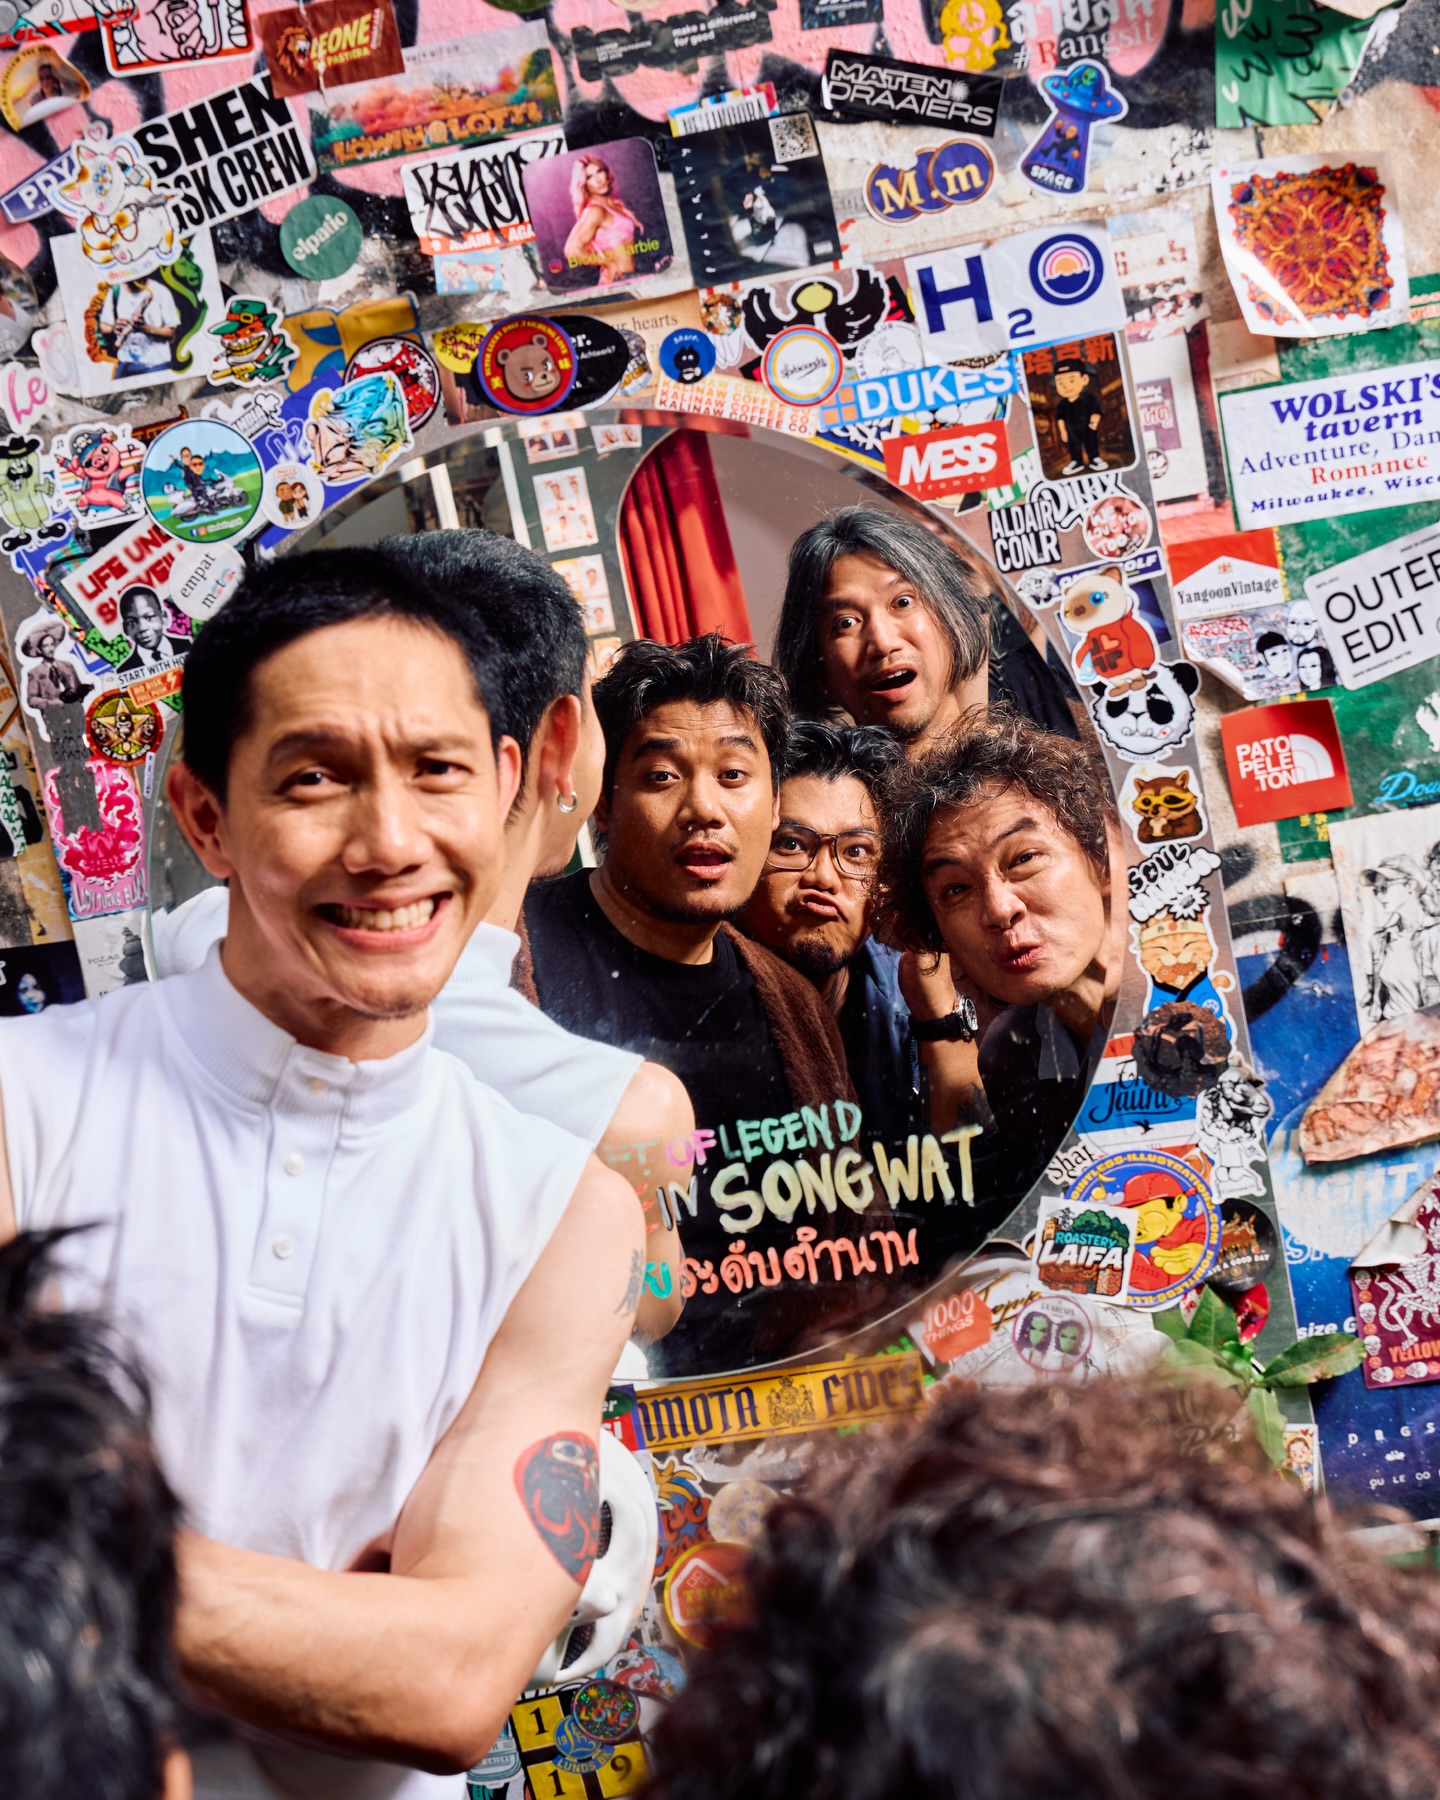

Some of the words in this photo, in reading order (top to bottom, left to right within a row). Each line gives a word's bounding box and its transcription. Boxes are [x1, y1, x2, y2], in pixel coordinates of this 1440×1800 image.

[310, 13, 372, 60] LEONE
[672, 24, 697, 38] make
[700, 22, 706, 31] a
[708, 11, 757, 29] difference
[674, 36, 692, 47] for
[695, 30, 715, 45] good
[829, 59, 953, 102] MATEN
[828, 79, 994, 127] DRAAIERS
[133, 74, 293, 178] SHEN
[217, 127, 312, 210] CREW
[1030, 164, 1074, 190] SPACE
[292, 209, 348, 262] elpatio
[632, 313, 678, 331] hearts
[661, 389, 725, 408] KALINAW
[731, 402, 785, 421] COFFEE
[856, 361, 1014, 419] DUKES
[659, 399, 723, 418] KALINAW
[729, 411, 784, 430] COFFEE
[788, 423, 812, 436] CO.
[1304, 408, 1423, 442] tavern
[898, 432, 999, 487] MESS
[1239, 440, 1379, 476] Adventure,
[1310, 454, 1429, 486] Romance
[1250, 485, 1374, 513] Milwaukee,
[990, 500, 1055, 540] ALDAIR
[76, 555, 129, 601] LIFE
[180, 551, 217, 599] empat
[1341, 602, 1424, 664] EDIT
[118, 667, 146, 686] START
[148, 659, 173, 678] WITH
[1235, 735, 1292, 763] PATO
[1238, 752, 1295, 779] PELE
[1254, 768, 1300, 792] TON
[718, 1099, 863, 1163] LEGEND
[1038, 1239, 1125, 1271] LAIFA
[1055, 1231, 1118, 1250] ROASTERY
[923, 1313, 975, 1344] THINGS
[529, 1706, 549, 1736] 1
[547, 1769, 567, 1797] 1
[609, 1754, 633, 1783] 9
[557, 1758, 597, 1773] LUNDS
